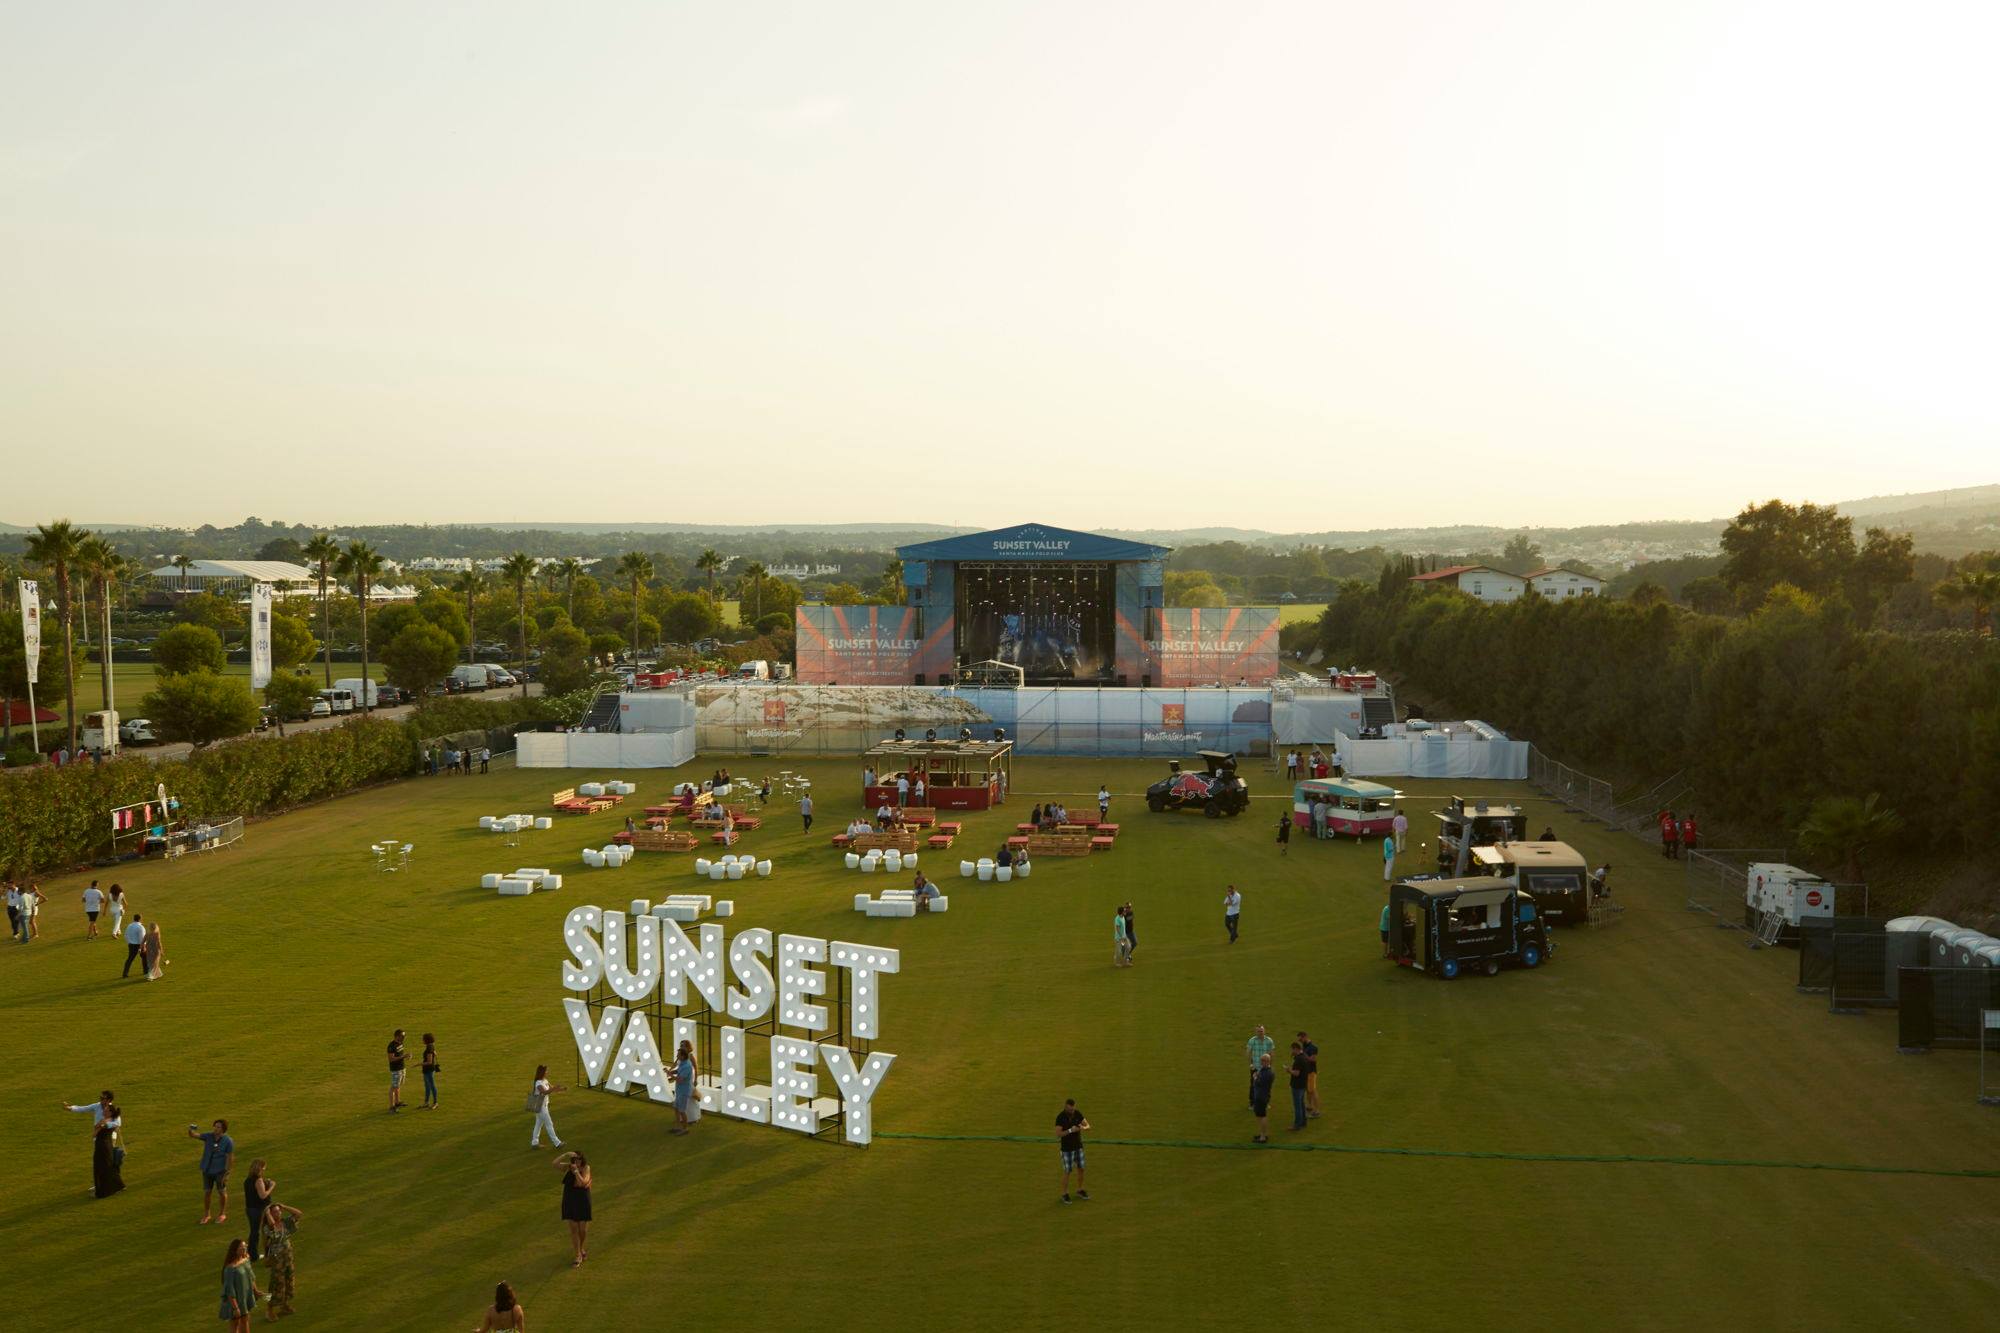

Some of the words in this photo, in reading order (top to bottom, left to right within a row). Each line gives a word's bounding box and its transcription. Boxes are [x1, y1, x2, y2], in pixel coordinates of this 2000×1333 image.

[993, 540, 1032, 550] SUNSET
[1033, 540, 1071, 550] VALLEY
[828, 639, 872, 650] SUNSET
[875, 639, 919, 649] VALLEY
[1149, 640, 1196, 651] SUNSET
[1198, 640, 1244, 651] VALLEY
[562, 904, 900, 1040] SUNSET
